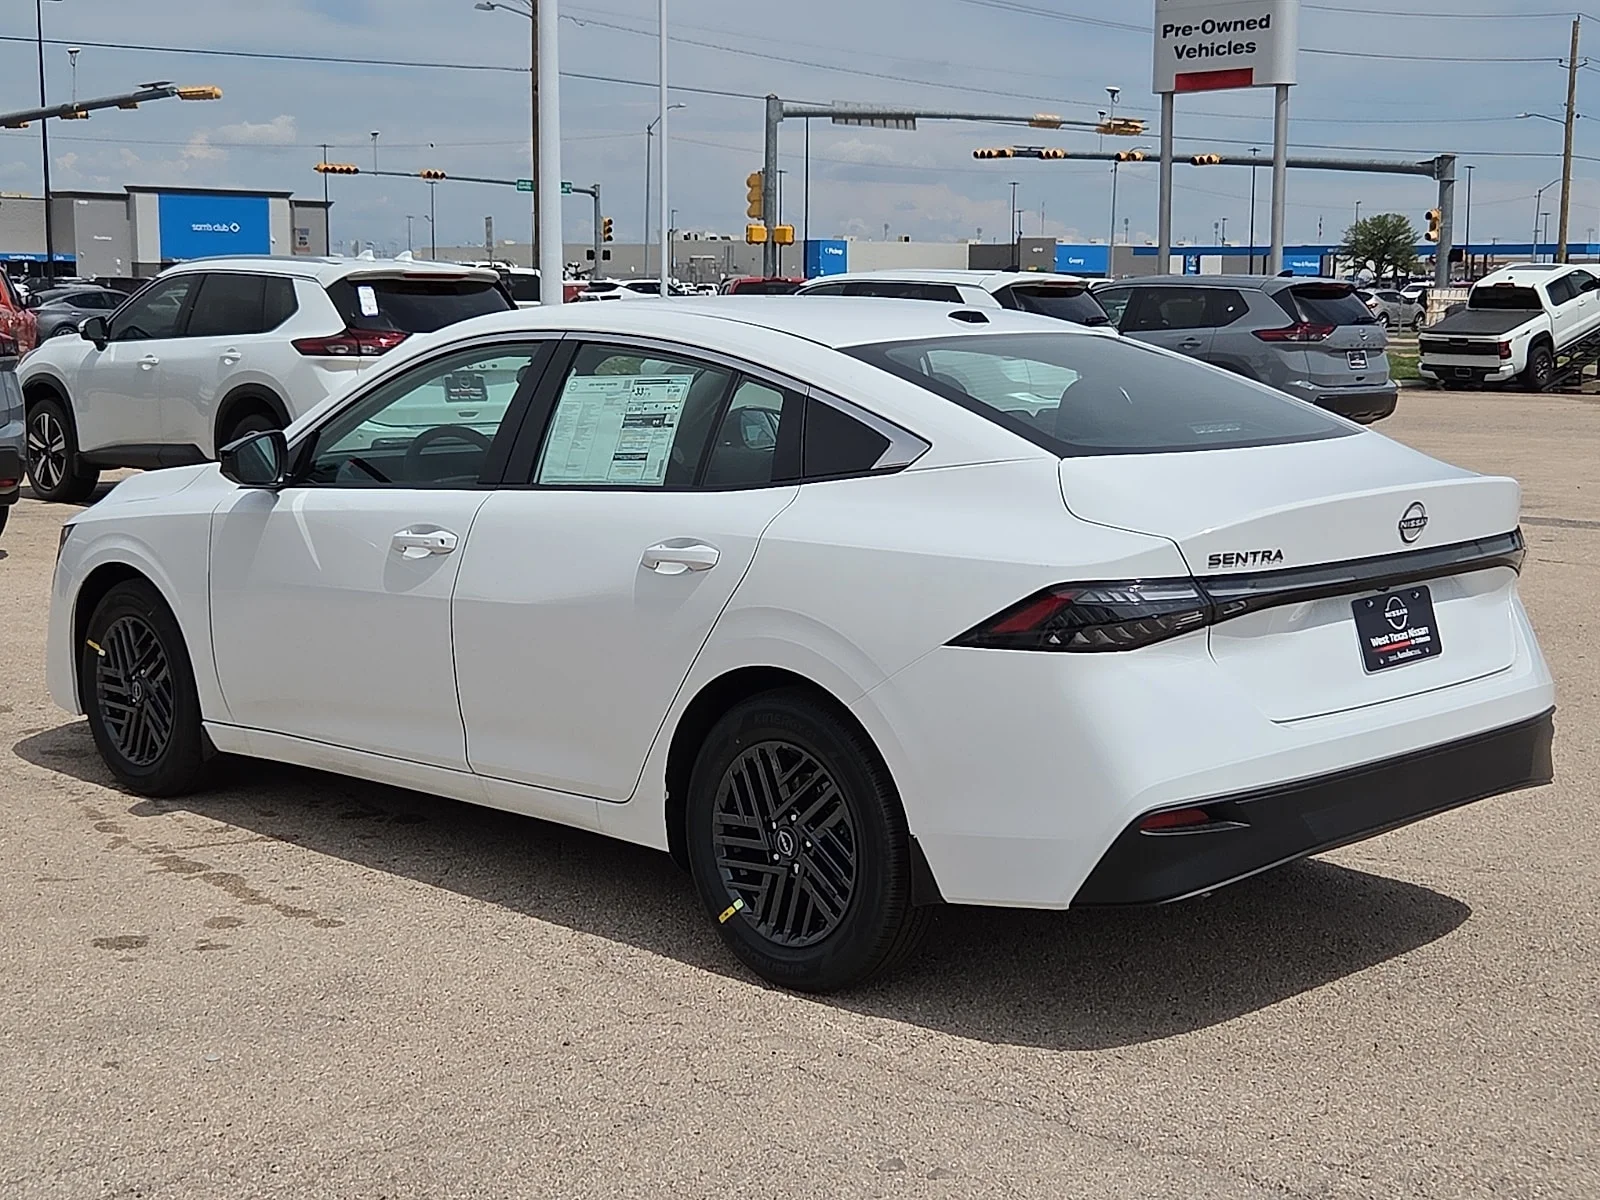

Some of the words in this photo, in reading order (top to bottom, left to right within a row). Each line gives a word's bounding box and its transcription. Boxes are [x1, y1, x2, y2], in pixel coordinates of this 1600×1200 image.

[1162, 13, 1271, 39] Pre-Owned
[1173, 40, 1257, 59] Vehicles
[213, 223, 229, 232] club
[1208, 549, 1284, 567] SENTRA
[1385, 608, 1408, 618] NISSAN
[1370, 634, 1390, 647] West
[1390, 631, 1409, 643] Texas
[1408, 626, 1429, 638] Nissan
